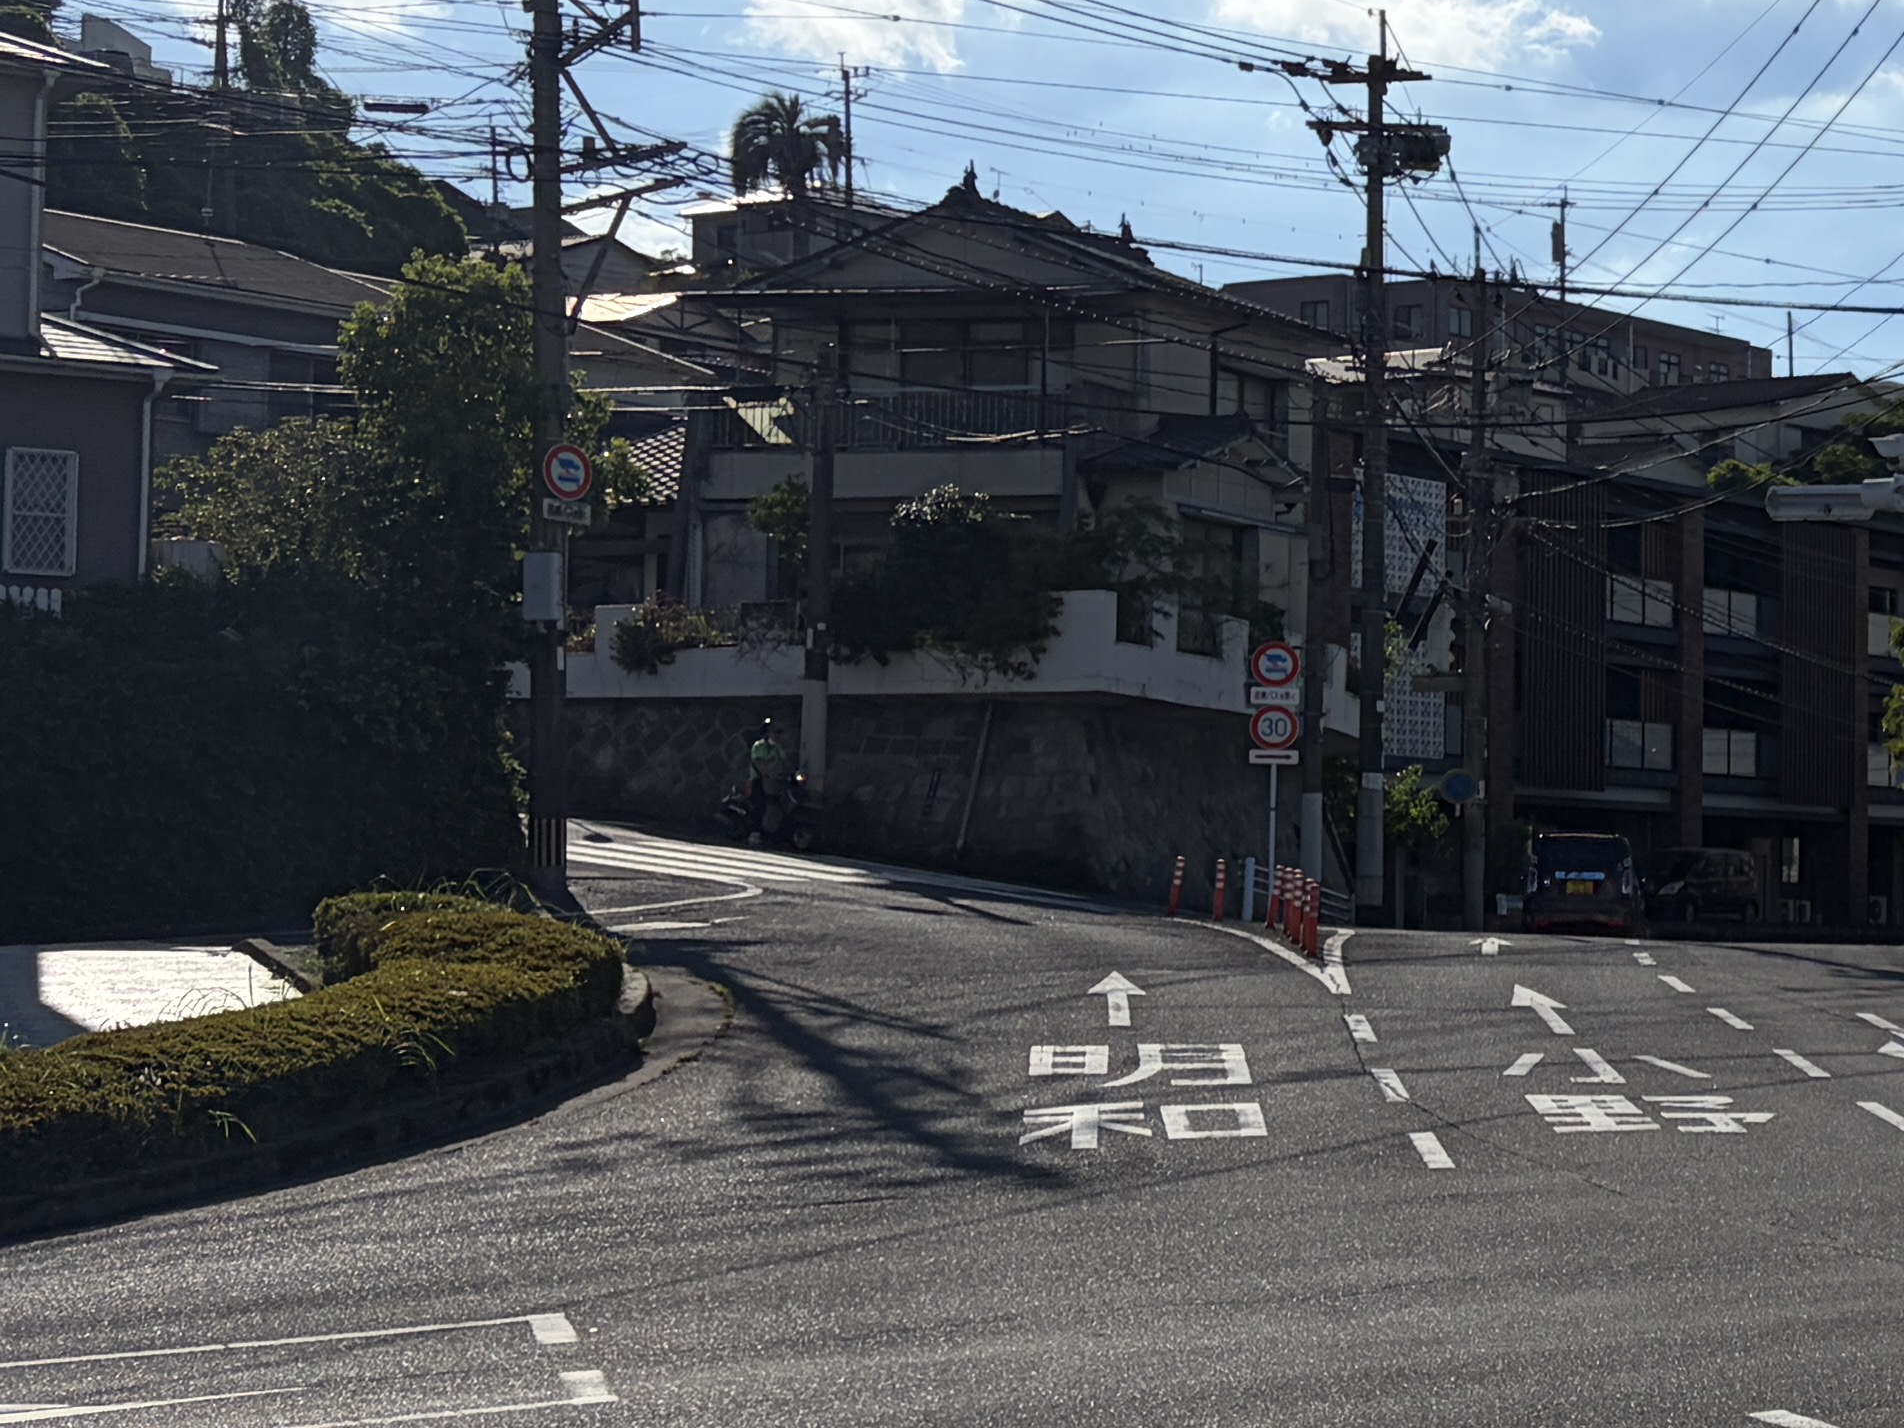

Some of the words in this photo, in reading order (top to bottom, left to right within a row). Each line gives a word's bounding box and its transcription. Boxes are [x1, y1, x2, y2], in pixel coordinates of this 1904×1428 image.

[1261, 718, 1288, 737] 30
[1019, 1043, 1268, 1149] 明和
[1502, 1048, 1777, 1133] 小野
